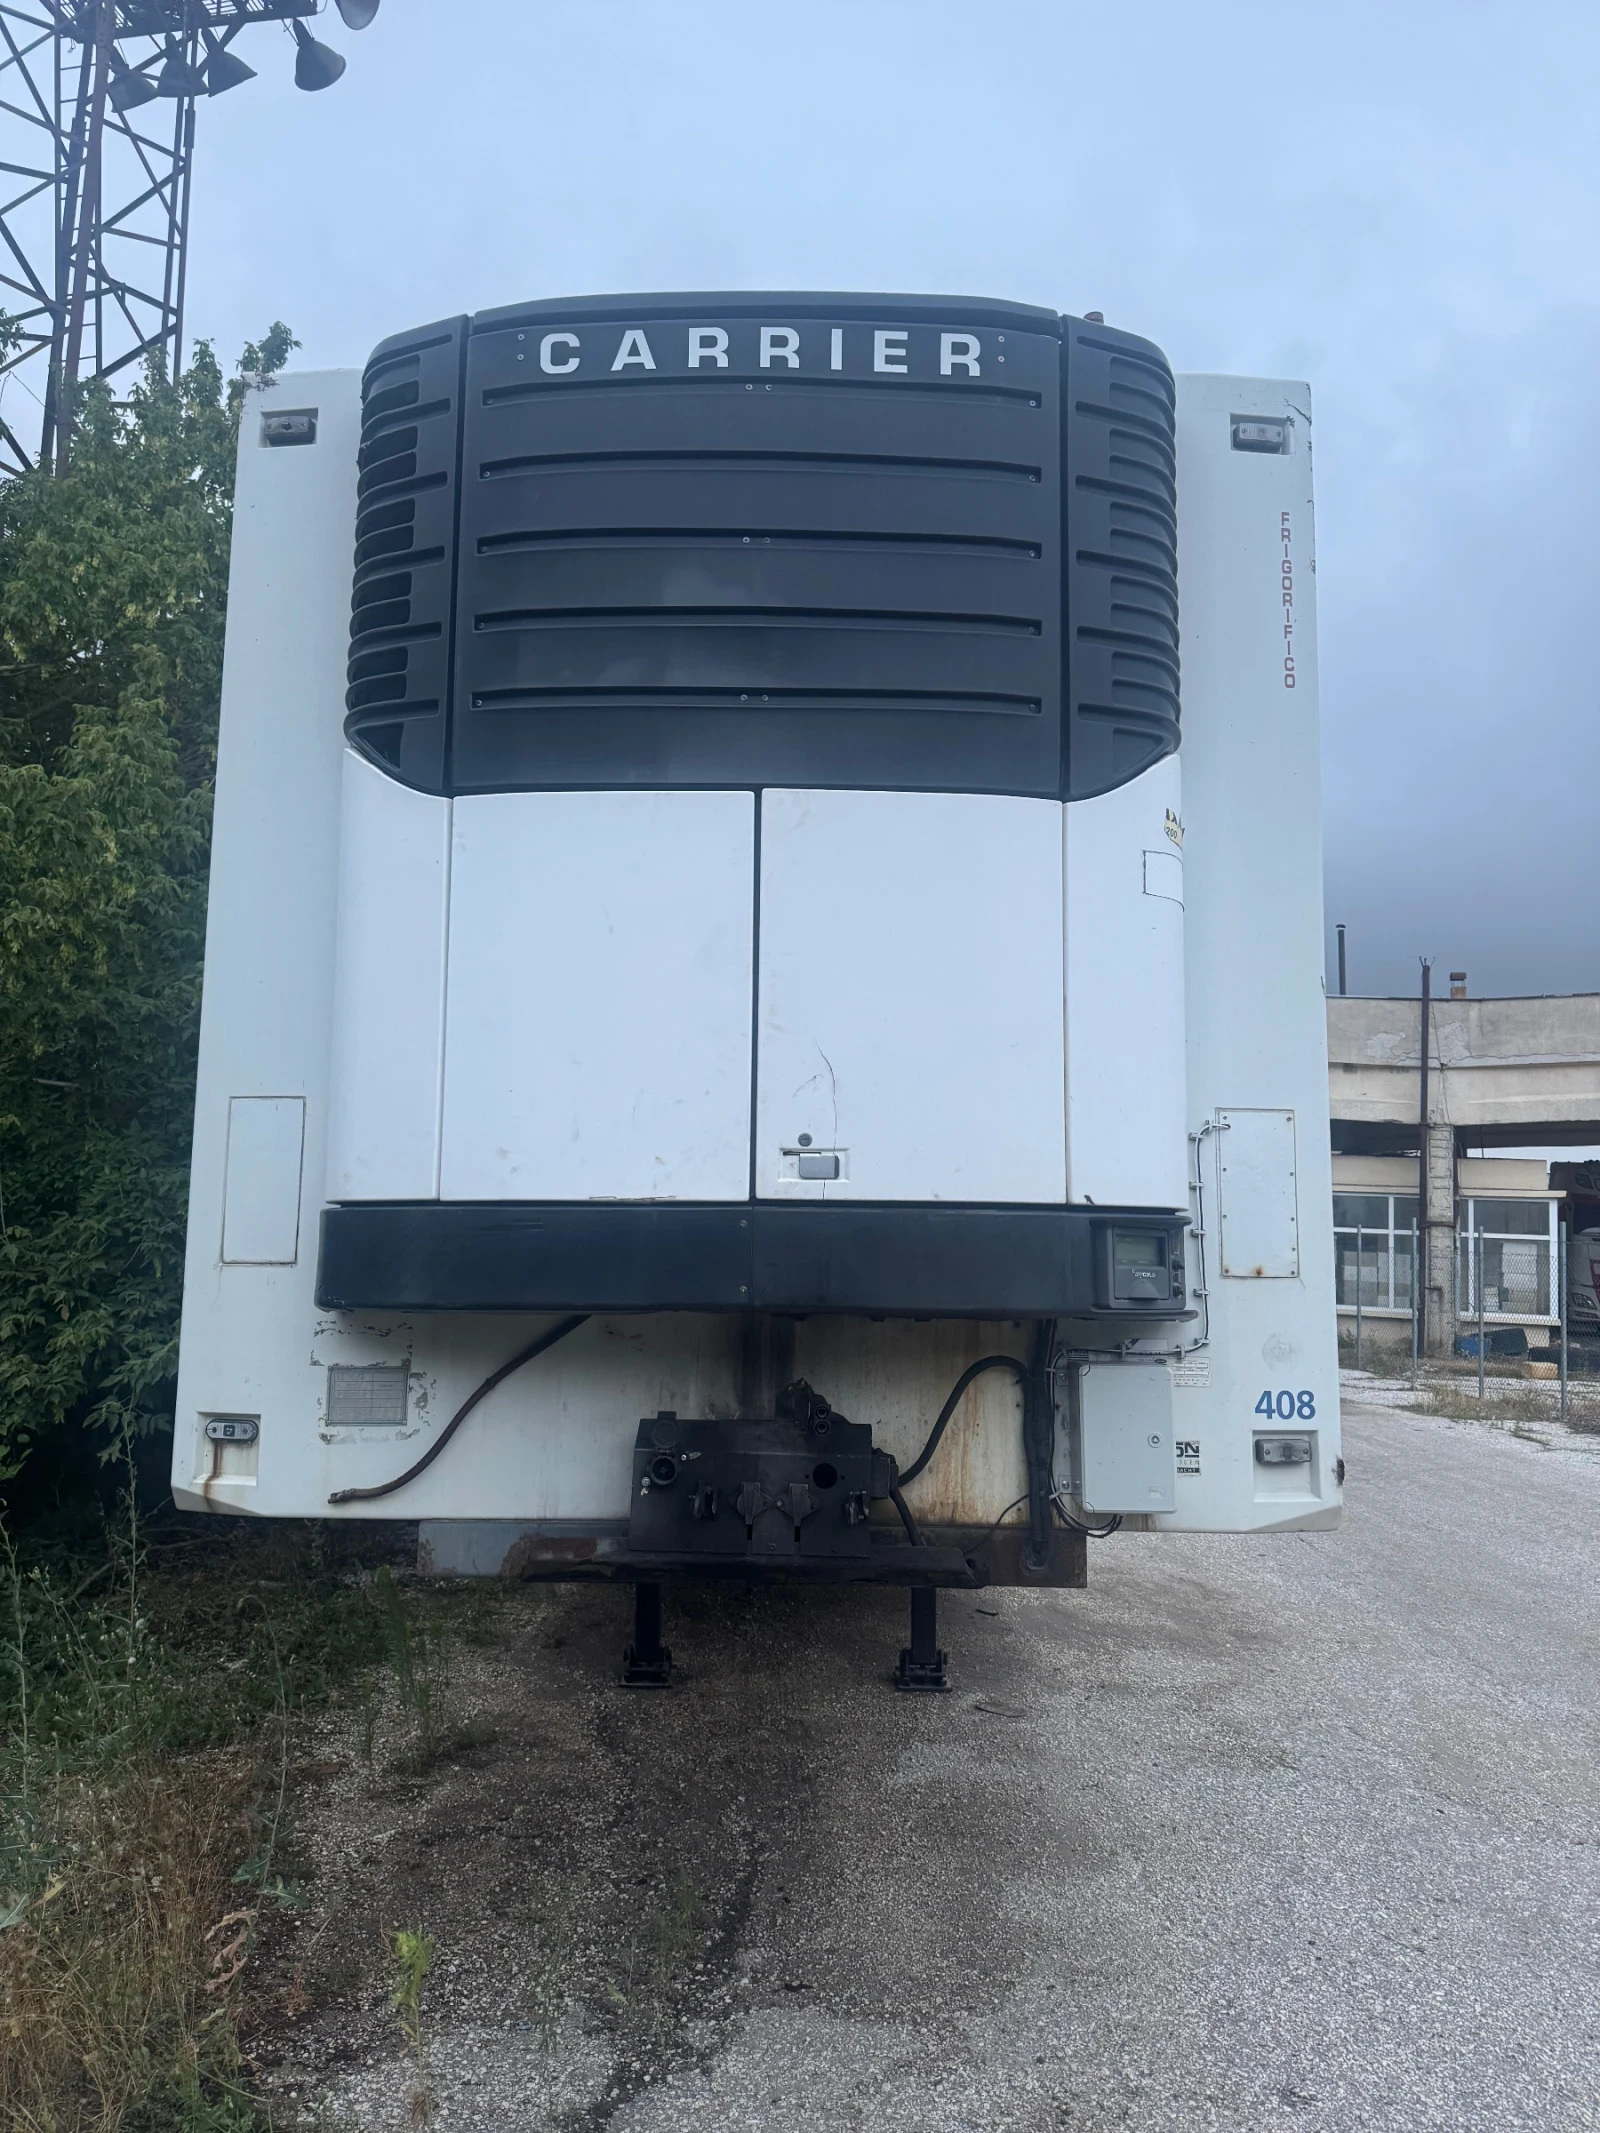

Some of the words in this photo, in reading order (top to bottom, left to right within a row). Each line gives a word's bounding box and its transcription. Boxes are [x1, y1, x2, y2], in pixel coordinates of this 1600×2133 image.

[539, 326, 982, 377] CARRIER
[1281, 511, 1296, 689] FRIGORIFICO
[1254, 1389, 1316, 1420] 408
